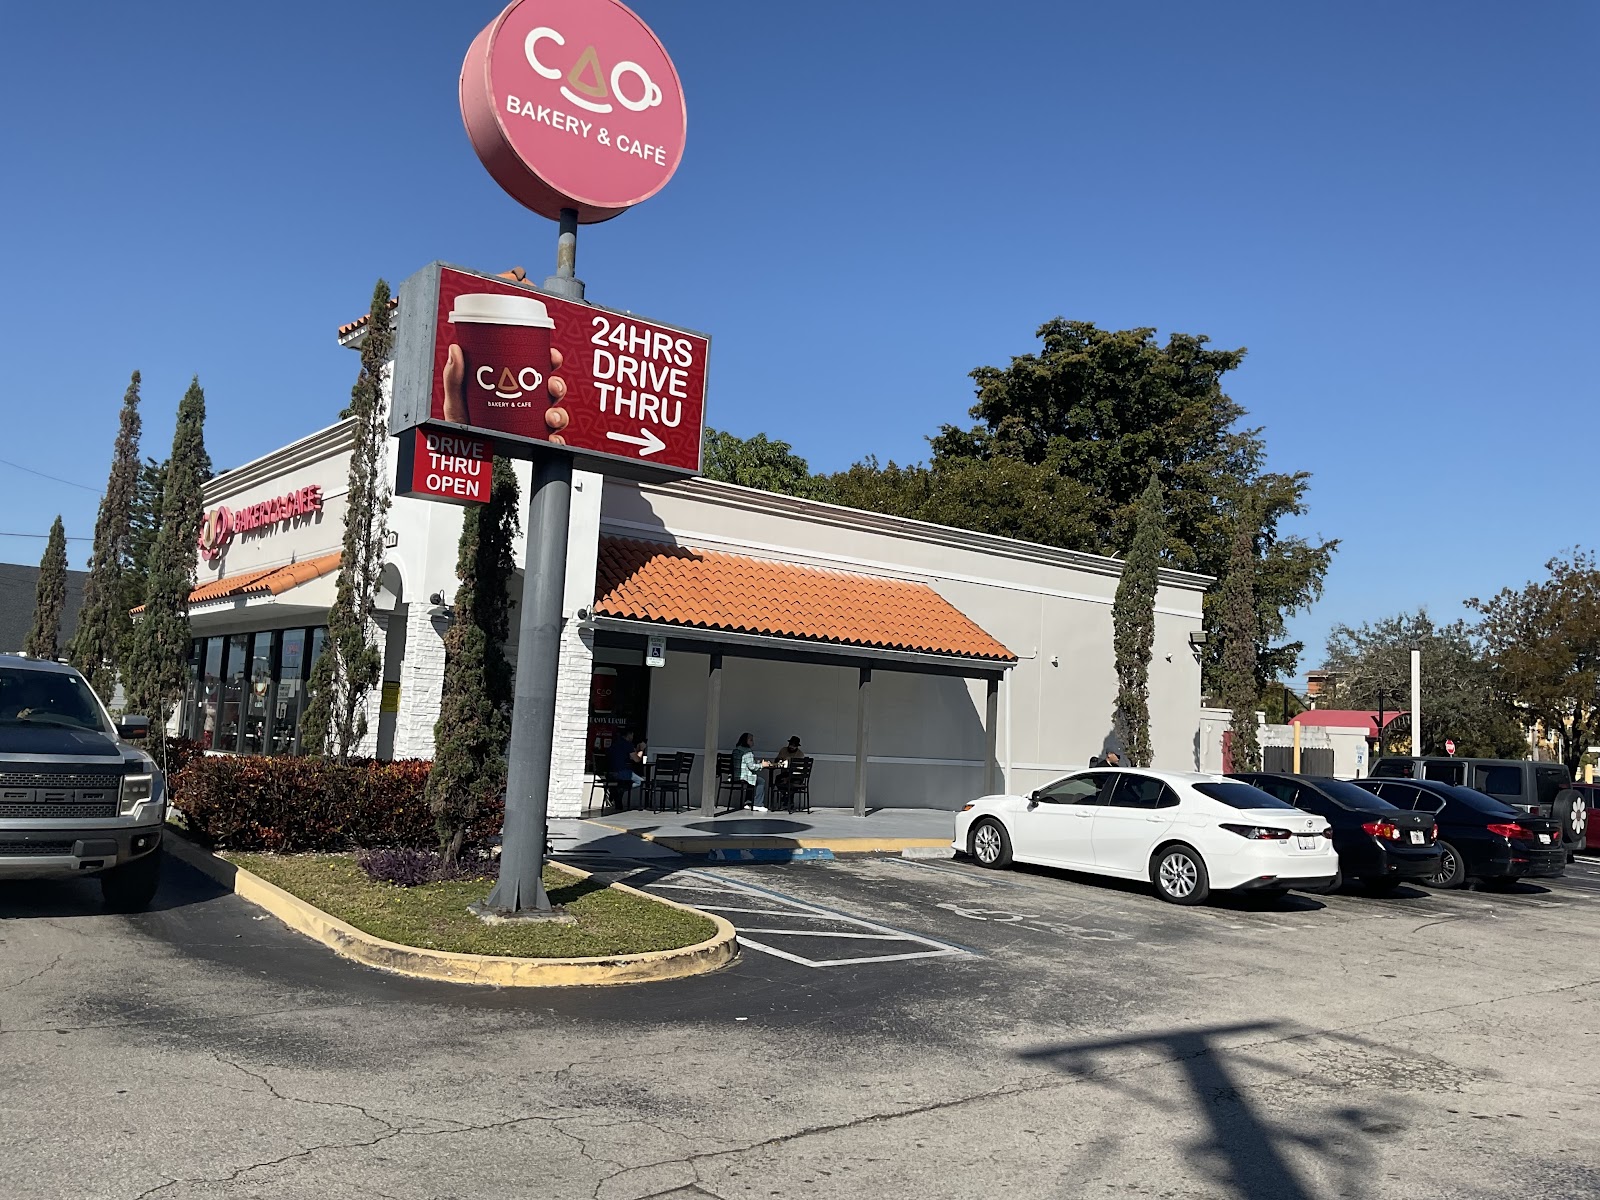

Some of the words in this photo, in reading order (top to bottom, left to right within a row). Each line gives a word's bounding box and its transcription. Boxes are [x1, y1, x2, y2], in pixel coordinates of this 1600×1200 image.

[524, 26, 663, 112] CAO
[506, 94, 593, 139] BAKERY
[596, 127, 611, 147] &
[616, 134, 667, 167] CAFÉ
[590, 316, 693, 368] 24HRS
[476, 365, 543, 392] CAO
[592, 349, 689, 399] DRIVE
[593, 381, 683, 428] THRU
[426, 434, 484, 459] DRIVE
[429, 452, 481, 477] THRU
[426, 473, 480, 497] OPEN
[234, 499, 275, 533] BAKERY
